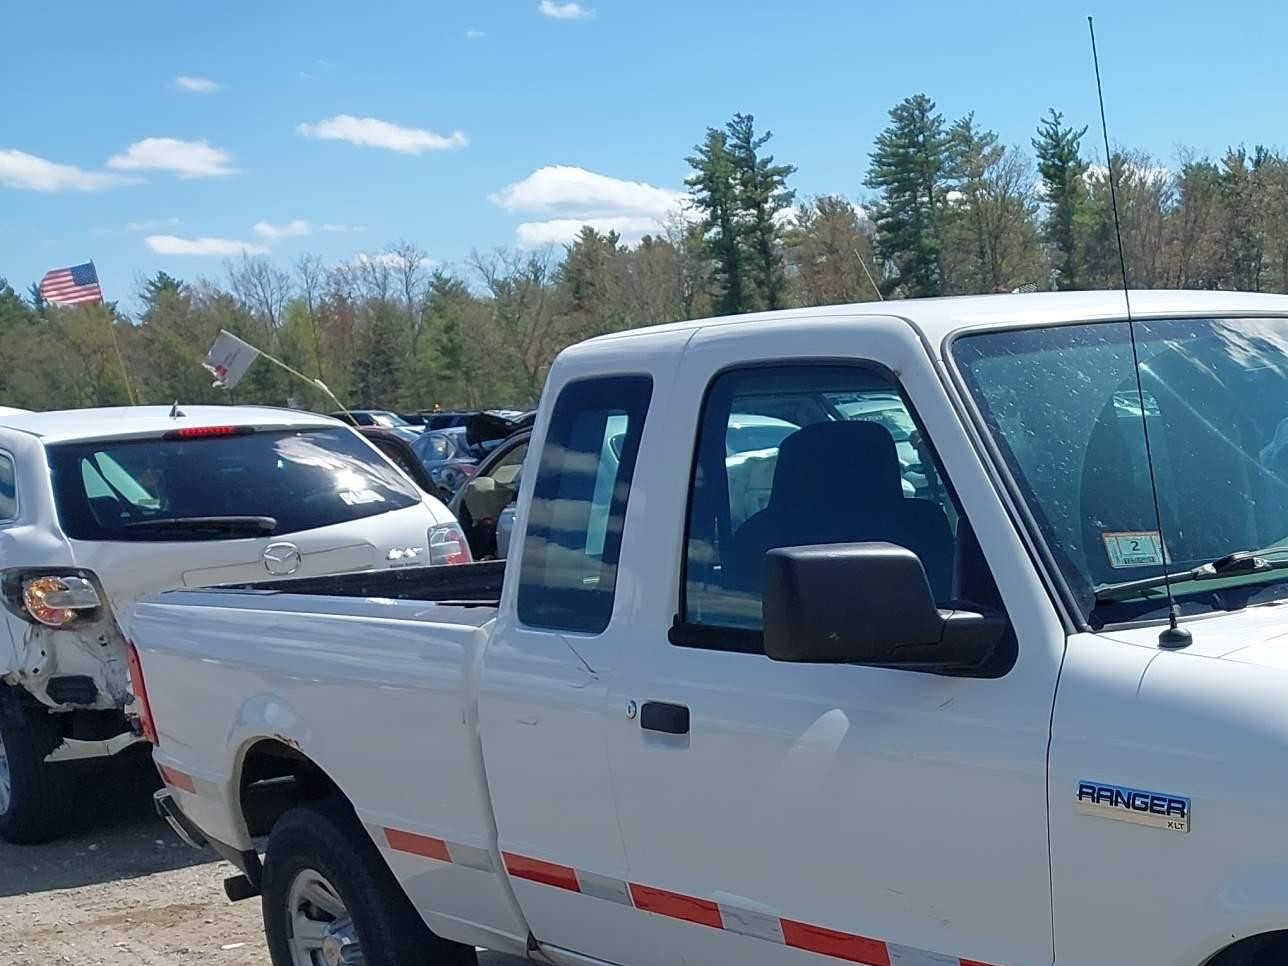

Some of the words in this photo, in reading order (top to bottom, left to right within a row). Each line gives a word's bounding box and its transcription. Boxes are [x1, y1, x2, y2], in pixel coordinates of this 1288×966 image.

[1130, 541, 1141, 551] 2
[1078, 783, 1188, 818] RANGER
[1167, 821, 1184, 831] XLT
